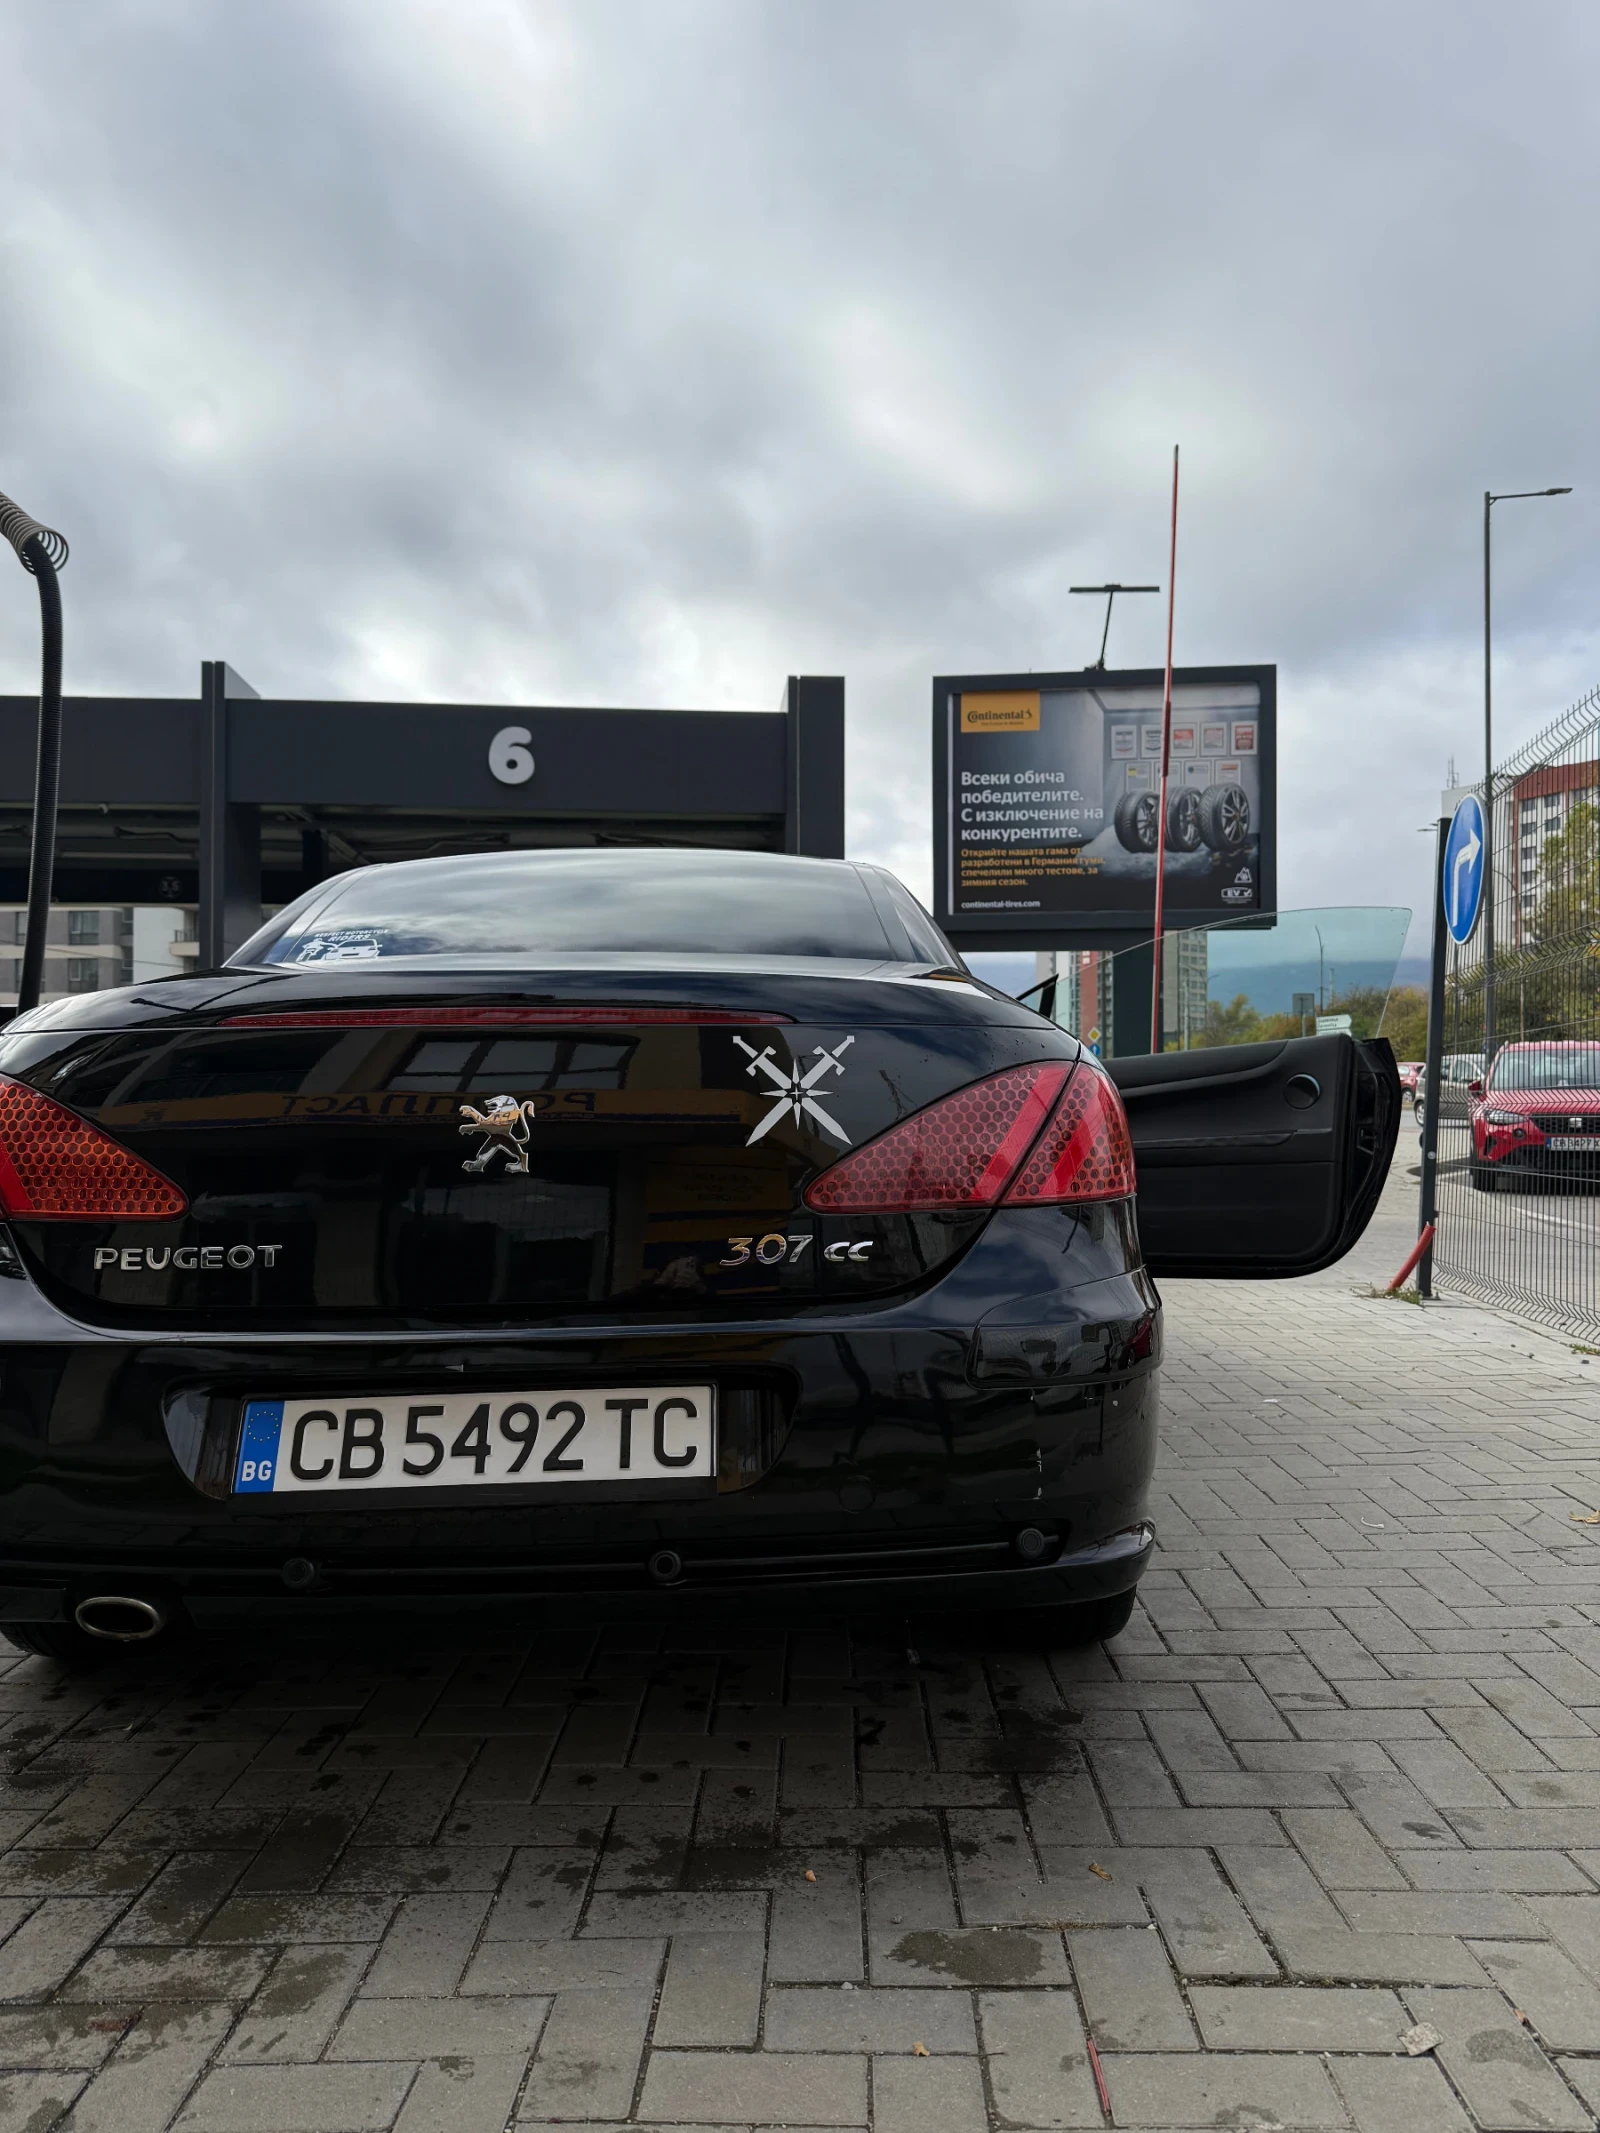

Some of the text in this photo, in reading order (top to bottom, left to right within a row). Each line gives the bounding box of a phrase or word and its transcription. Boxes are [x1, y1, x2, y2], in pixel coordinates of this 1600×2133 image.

[967, 710, 1024, 723] Continental
[488, 726, 535, 785] 6
[961, 770, 1065, 785] Всеки обича
[961, 789, 1084, 805] победителите.
[961, 807, 1104, 822] С изключение на
[961, 826, 1082, 842] конкурентите.
[961, 848, 1007, 858] Открийте
[1008, 848, 1044, 857] нашата
[1046, 847, 1069, 856] гама
[961, 857, 1022, 868] разработени
[1031, 856, 1078, 867] Германия
[961, 868, 1012, 878] спечелили
[1014, 868, 1044, 876] много
[1087, 867, 1098, 875] за
[961, 878, 1028, 887] зимния сезон.
[961, 900, 1041, 909] continental-tires.com
[328, 934, 372, 942] RIDERS
[719, 1233, 814, 1266] 307
[93, 1244, 283, 1271] PEUGEOT
[290, 1397, 698, 1481] CB 5492 TC
[240, 1460, 273, 1482] BG
